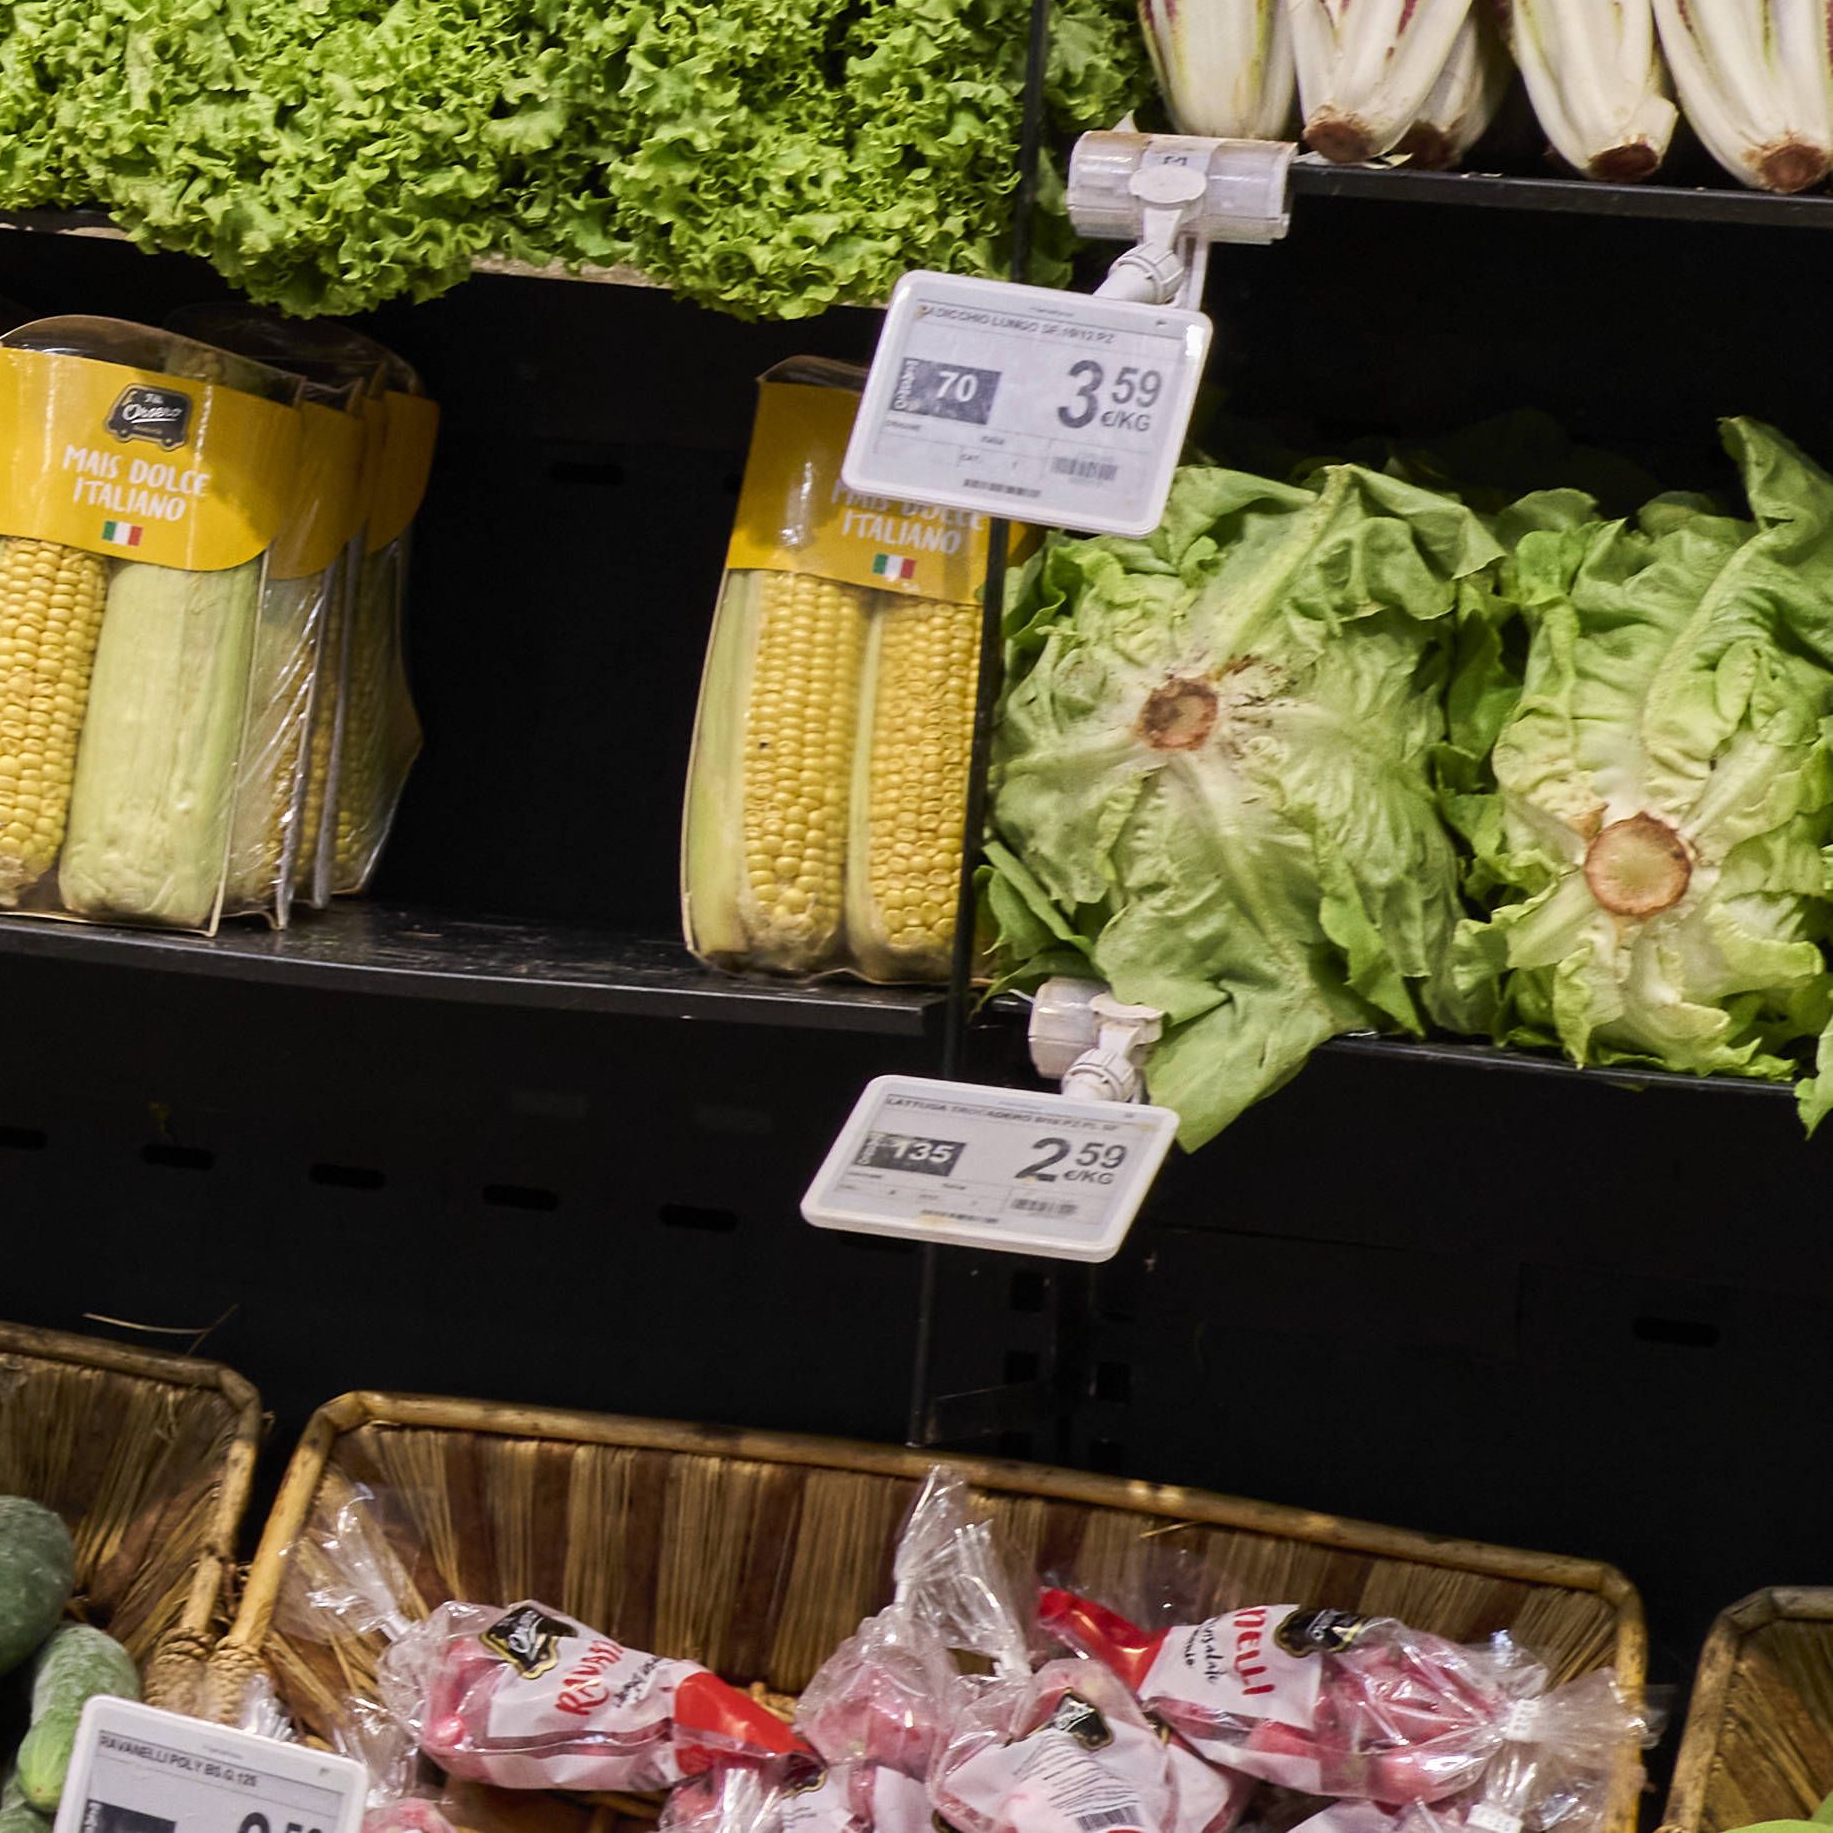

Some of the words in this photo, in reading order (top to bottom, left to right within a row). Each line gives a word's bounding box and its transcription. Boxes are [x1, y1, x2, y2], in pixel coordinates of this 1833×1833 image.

[935, 370, 978, 403] 70
[1057, 359, 1105, 429] 3
[1112, 366, 1162, 409] 59
[122, 403, 183, 421] Orsero
[1101, 408, 1152, 433] €/KG
[62, 444, 122, 479] MAIS
[129, 458, 211, 497] DOLCE
[73, 477, 186, 521] ITALIANO
[843, 511, 963, 555] ITALIANO
[886, 1096, 948, 1113] LATTUGA
[890, 1138, 954, 1165] 135
[1015, 1137, 1070, 1183] 2
[1076, 1142, 1129, 1169] 59
[1063, 1169, 1115, 1186] €/KG
[97, 1733, 170, 1767] RAVANELLI
[168, 1751, 202, 1775] POLY
